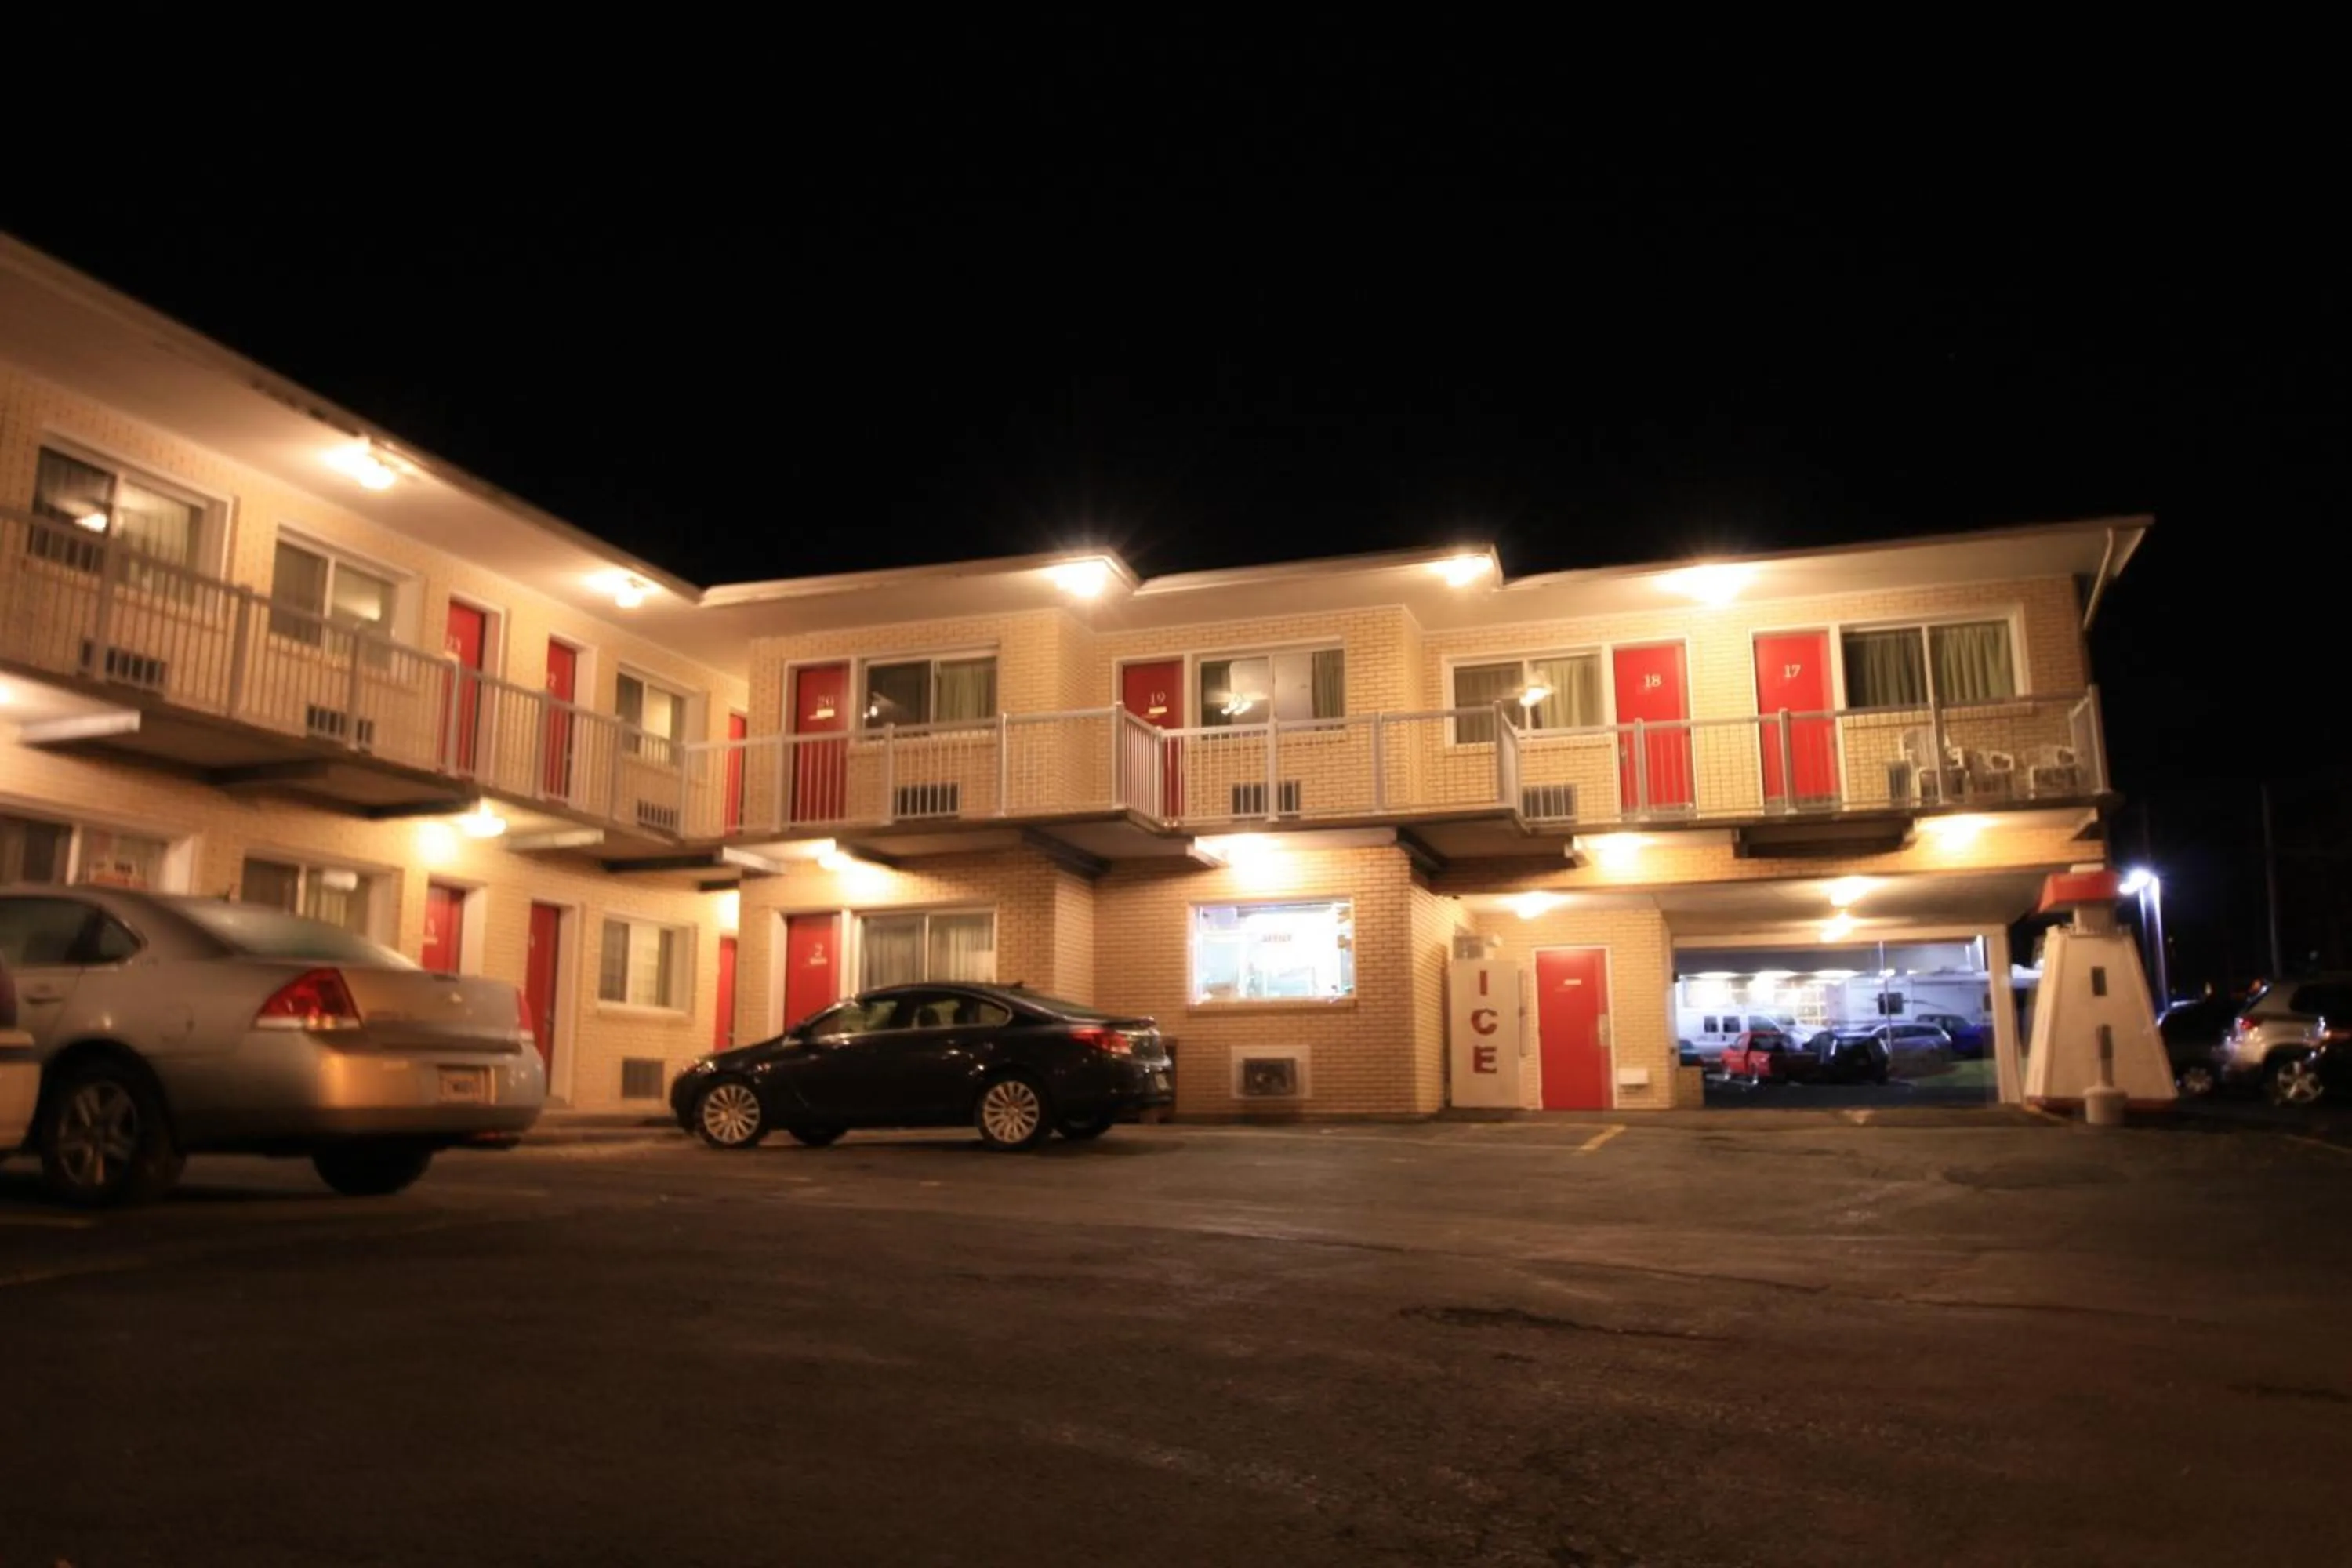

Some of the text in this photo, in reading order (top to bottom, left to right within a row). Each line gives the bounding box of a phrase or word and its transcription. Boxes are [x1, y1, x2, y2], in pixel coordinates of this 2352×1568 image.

[1784, 664, 1802, 678] 17
[1644, 673, 1661, 688] 18
[1149, 691, 1167, 705] 19
[1471, 970, 1498, 1074] ICE
